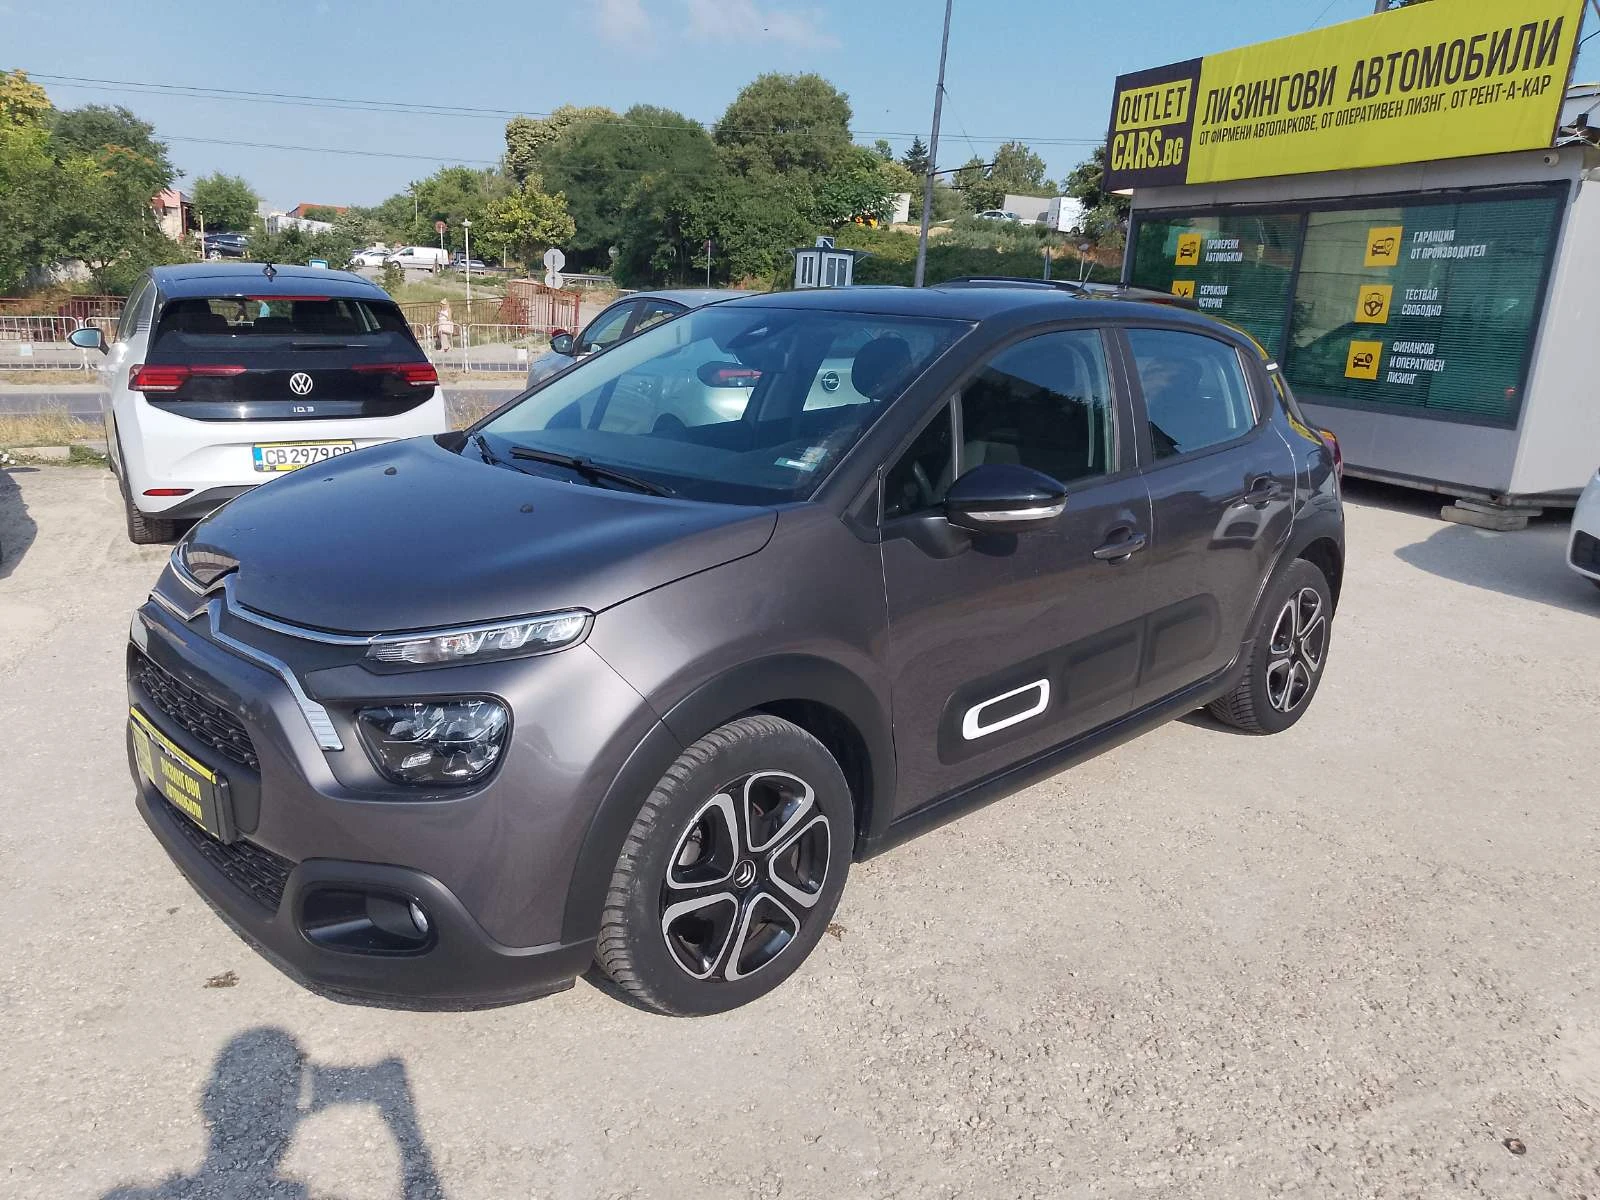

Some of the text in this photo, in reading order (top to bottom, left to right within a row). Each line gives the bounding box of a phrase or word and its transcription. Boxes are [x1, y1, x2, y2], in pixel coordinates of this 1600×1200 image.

[1202, 16, 1564, 126] ЛИЗИНГОВИ АВТОМОБИЛИ
[1120, 86, 1187, 125] OUTLET
[1199, 131, 1210, 145] ОТ
[1211, 123, 1251, 143] ФИРМЕНИ
[1253, 114, 1318, 138] АВТОПАРКОВЕ,
[1321, 112, 1334, 128] ОТ
[1335, 101, 1401, 127] ОПЕРАТИВЕН
[1451, 89, 1467, 108] ОТ
[1469, 75, 1551, 106] РЕНТ-А-КАР
[1111, 129, 1184, 171] CARS.BG
[1413, 230, 1455, 243] ГАРАНЦИЯ
[1410, 244, 1486, 260] ОТ ПРОИЗВОДИТЕЛ
[1405, 287, 1438, 301] ТЕСТВАЙ
[1401, 304, 1442, 317] СВОБОДНО
[1392, 341, 1435, 355] ФИНАНСОВ
[1389, 355, 1445, 372] И ОПЕРАТИВЕН
[1386, 371, 1417, 384] ЛИЗИНГ
[290, 447, 329, 464] 2979
